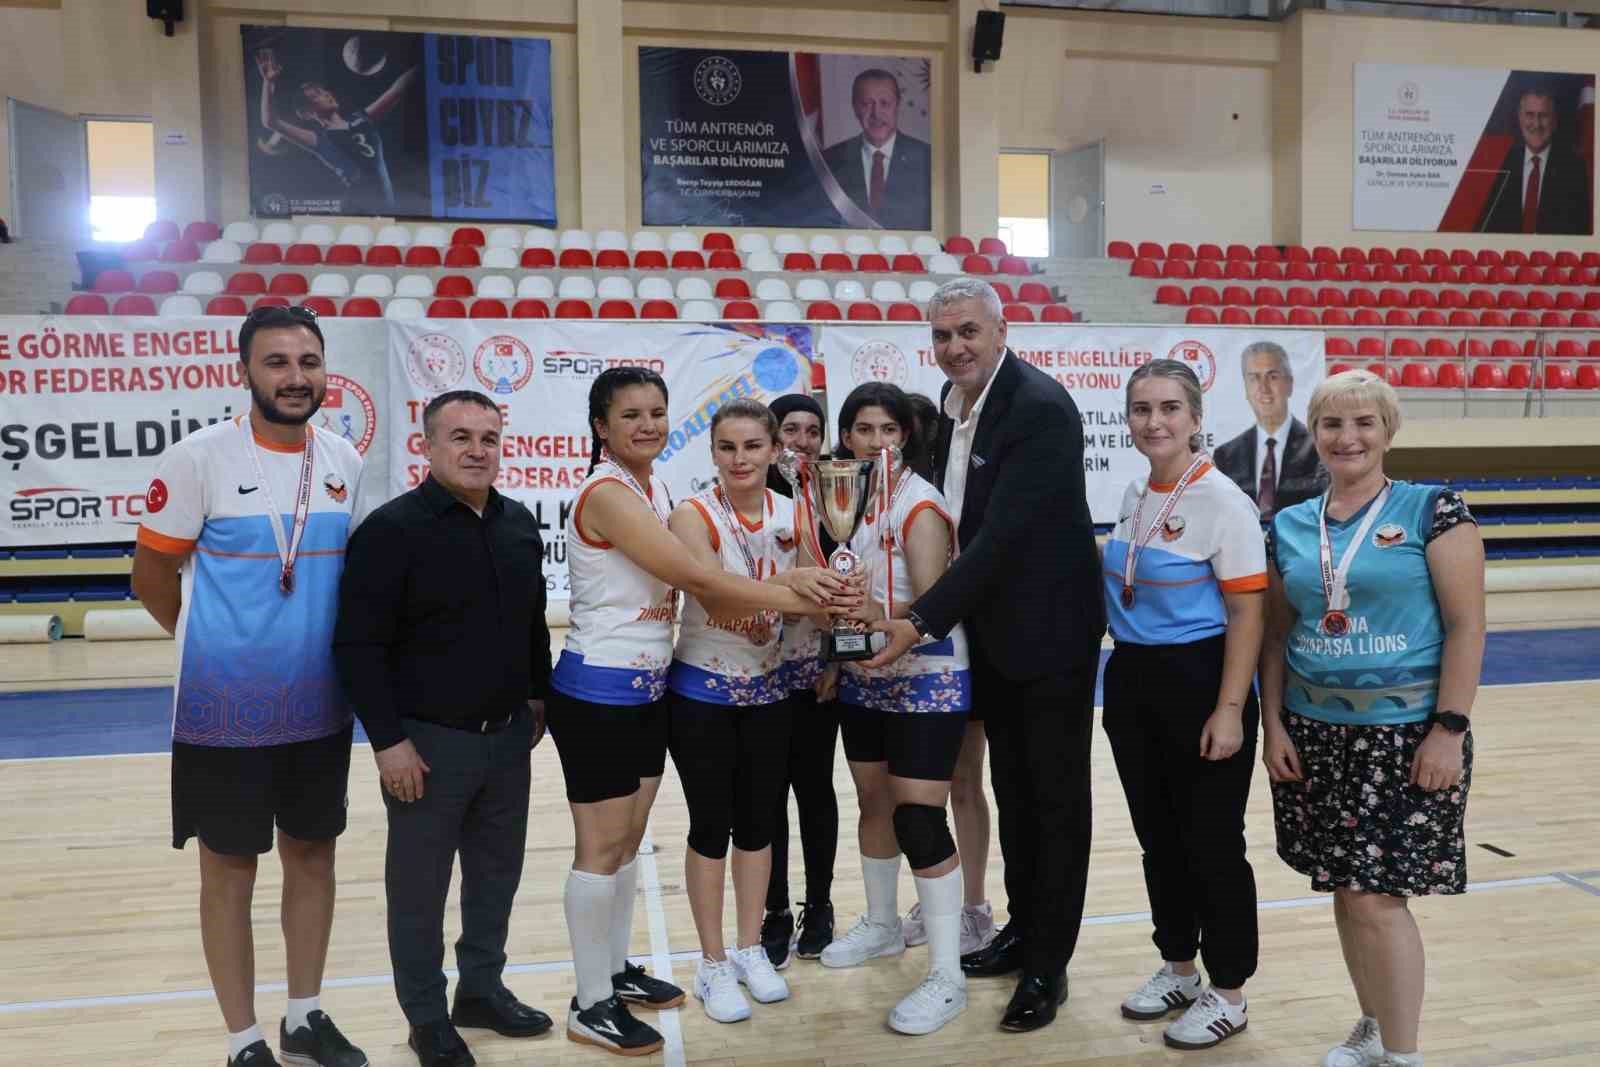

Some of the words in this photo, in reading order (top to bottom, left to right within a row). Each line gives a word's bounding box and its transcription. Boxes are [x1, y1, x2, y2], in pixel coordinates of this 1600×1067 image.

[665, 119, 697, 134] TÜM
[700, 121, 774, 136] ANTRENÖR
[650, 137, 668, 151] VE
[671, 139, 790, 155] SPORCULARIMIZA
[653, 155, 719, 167] BAŞARILAR
[720, 156, 785, 168] DİLİYORUM
[17, 327, 126, 360] GÖRME
[1099, 434, 1117, 448] VE
[1359, 632, 1408, 656] LİONS
